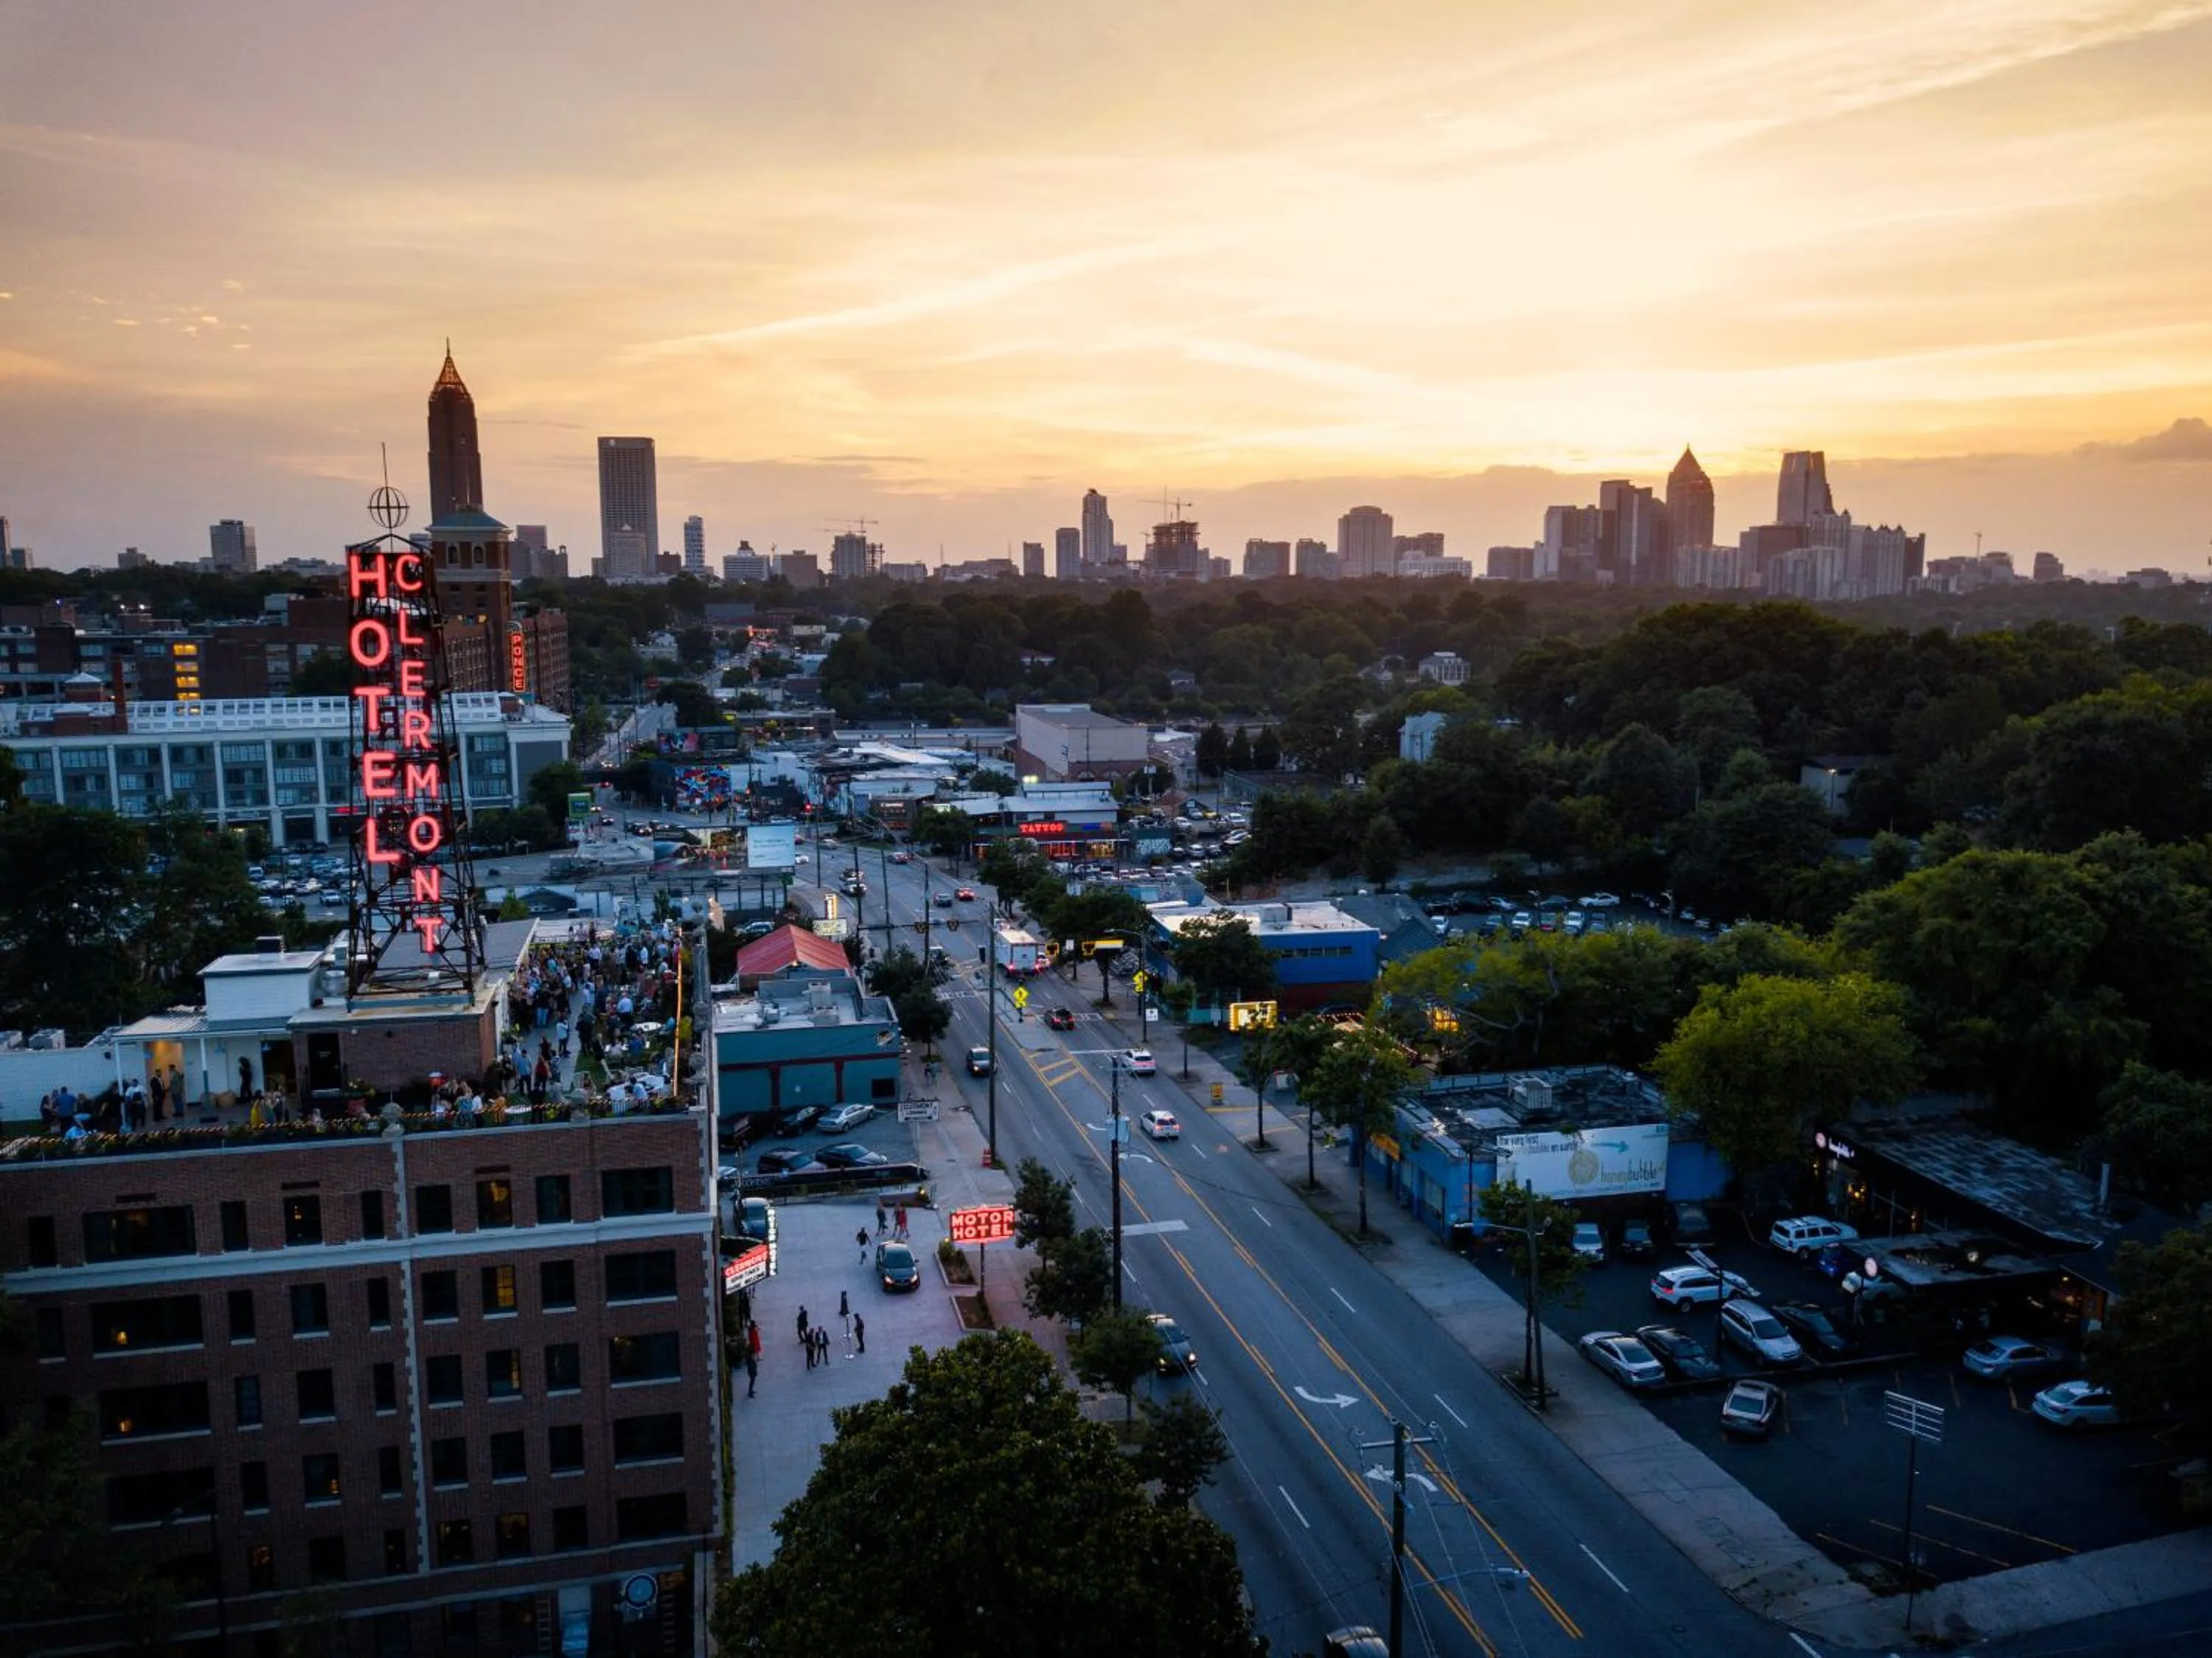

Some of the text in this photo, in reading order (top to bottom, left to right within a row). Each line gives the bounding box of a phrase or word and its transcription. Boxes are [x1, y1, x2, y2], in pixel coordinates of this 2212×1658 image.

[512, 635, 524, 688] PONCE
[349, 554, 400, 862] HOTEL
[394, 554, 443, 954] CLERMONT
[1020, 824, 1063, 833] TATTOO
[952, 1210, 1014, 1227] MOTOR
[953, 1224, 1014, 1239] HOTEL
